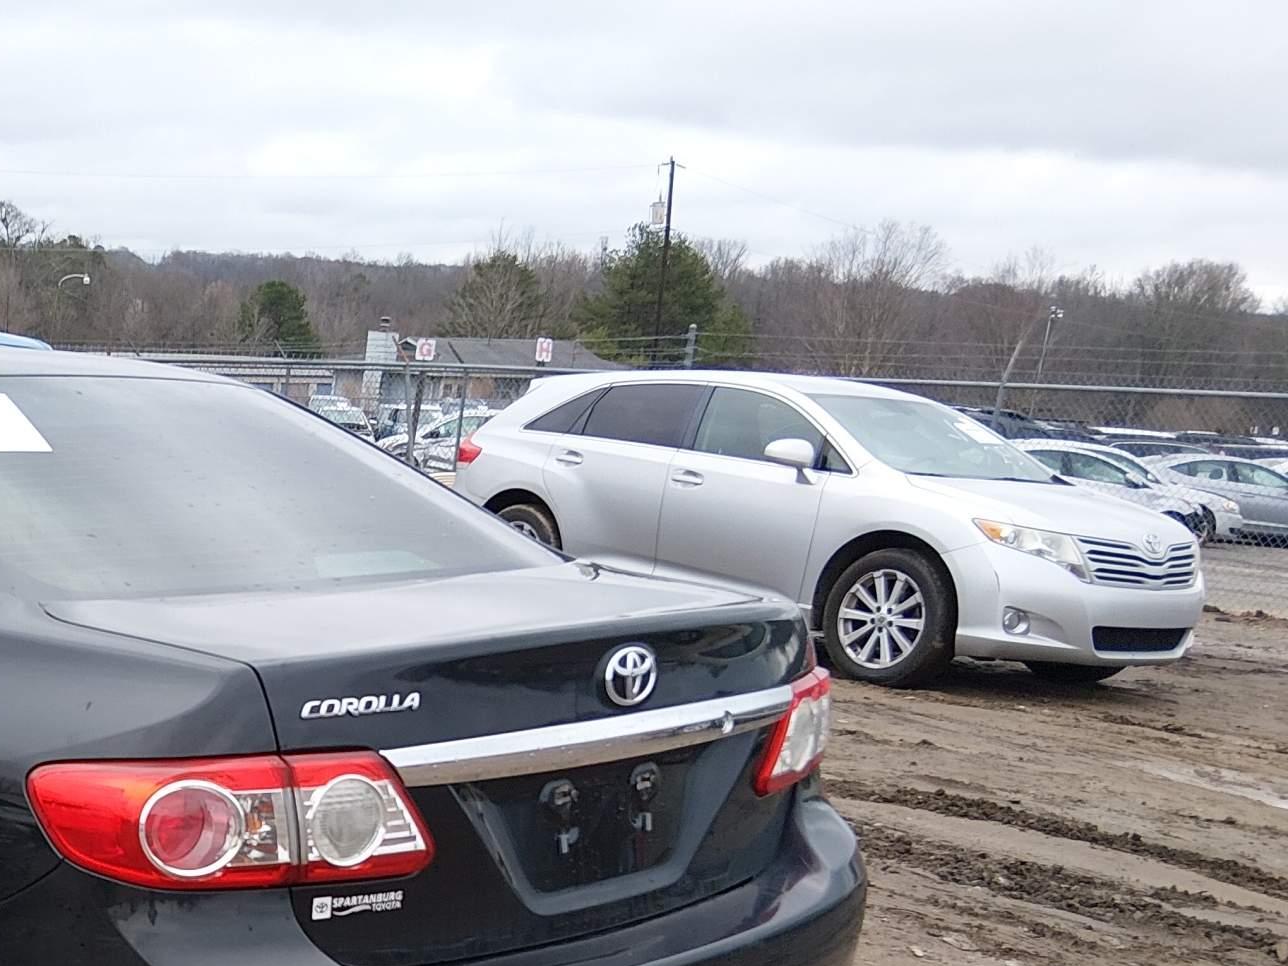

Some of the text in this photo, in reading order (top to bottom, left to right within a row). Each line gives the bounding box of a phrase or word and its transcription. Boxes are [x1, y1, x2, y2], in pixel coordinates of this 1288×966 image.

[419, 342, 432, 357] G
[300, 691, 421, 719] COROLLA
[332, 890, 404, 908] SPARTANBURG
[372, 901, 402, 912] TOYOTA
